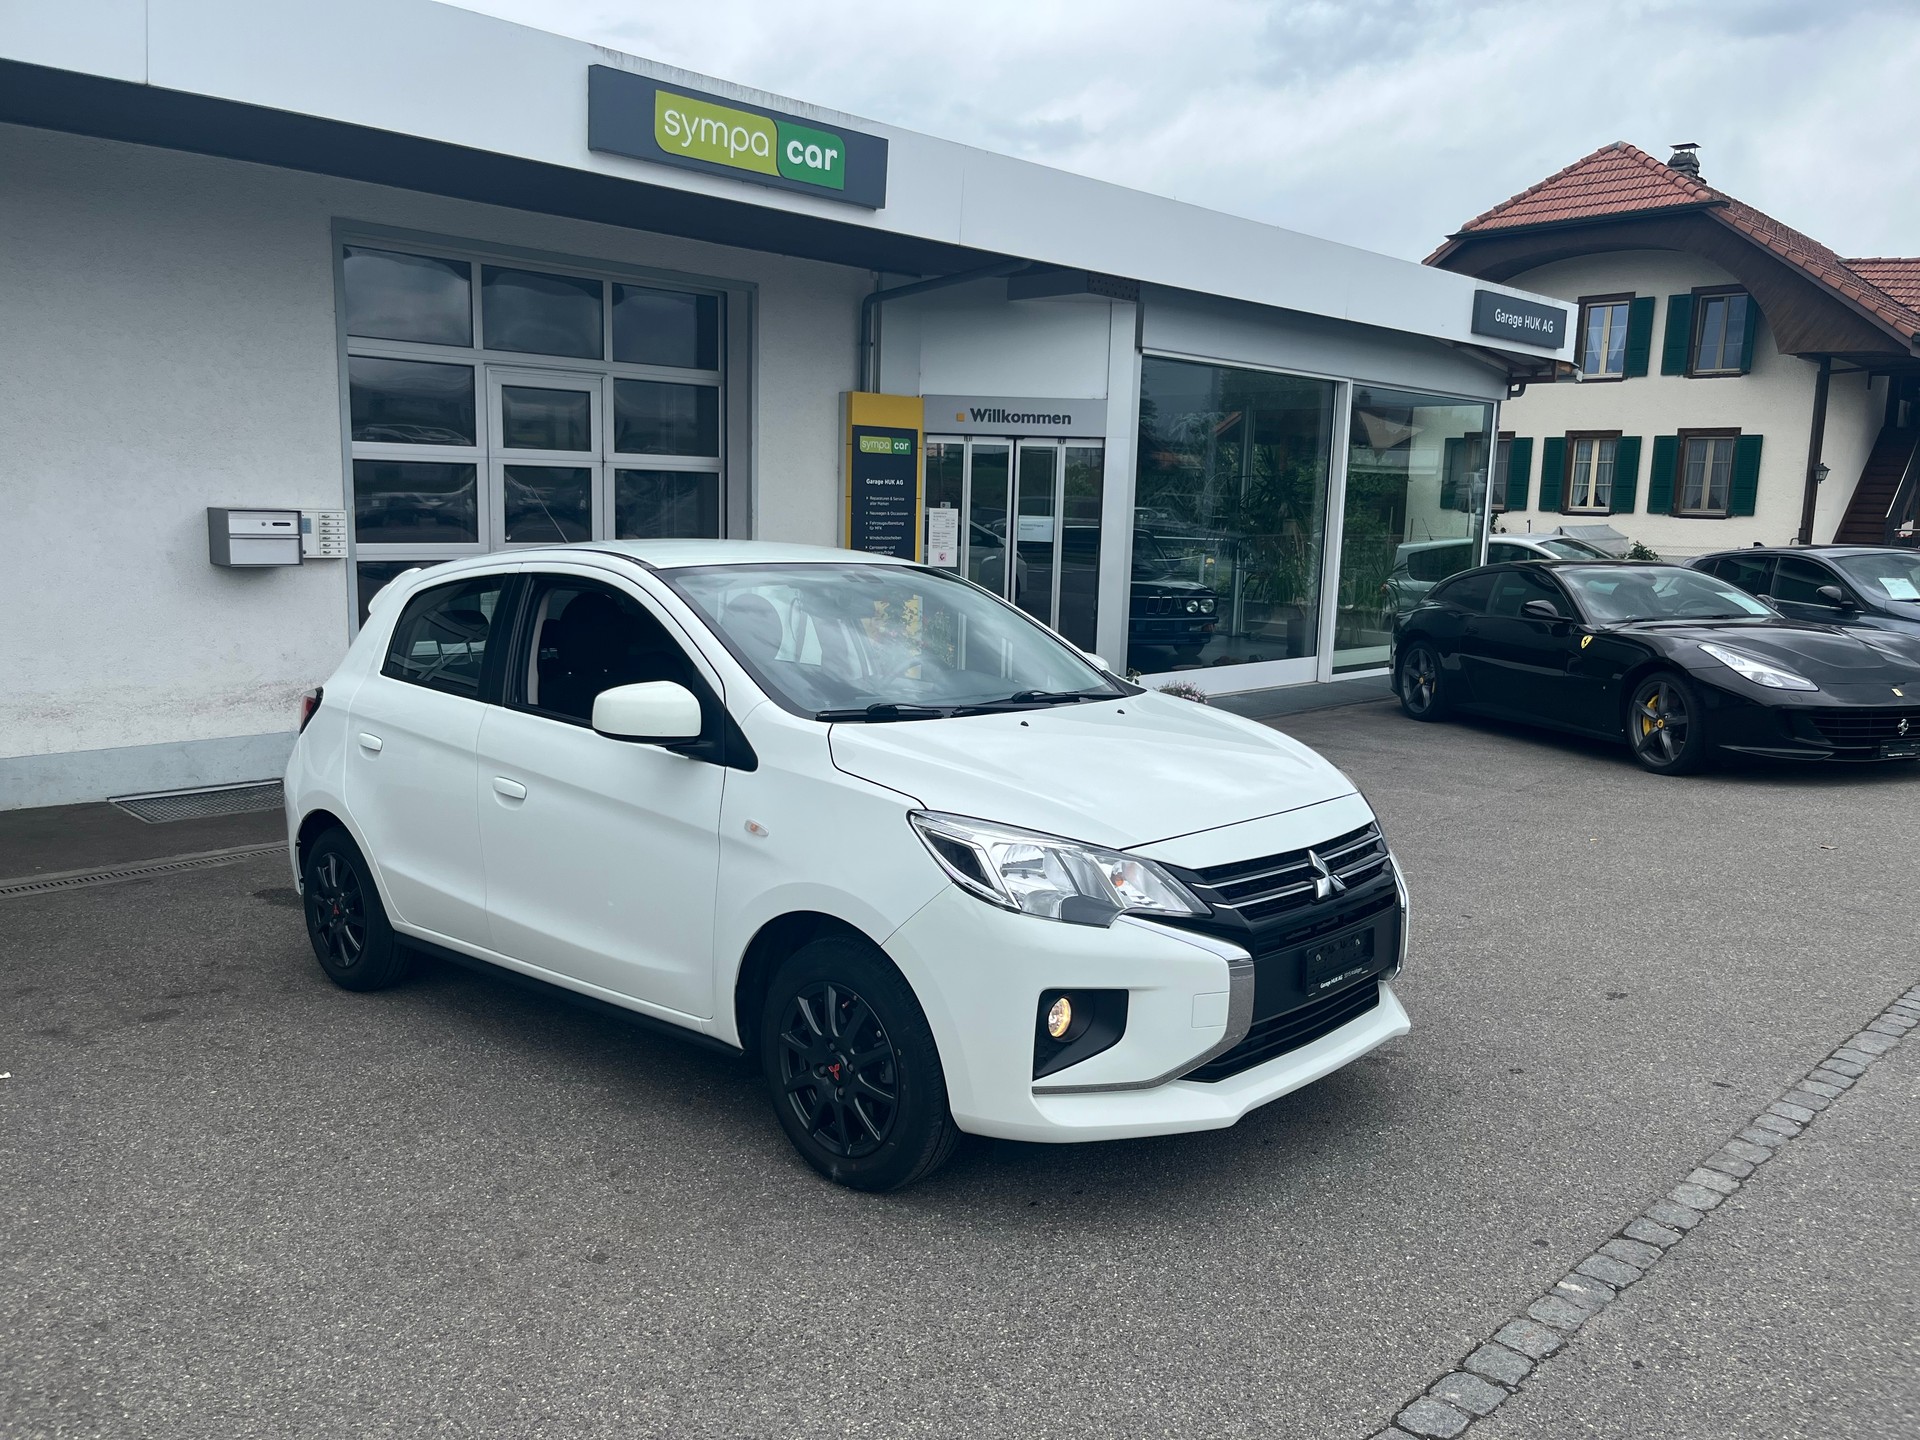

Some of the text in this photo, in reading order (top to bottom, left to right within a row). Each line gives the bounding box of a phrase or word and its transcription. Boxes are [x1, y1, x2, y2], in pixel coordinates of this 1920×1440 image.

[664, 110, 837, 171] sympa car
[1495, 308, 1554, 333] Garage HUK AG
[970, 408, 1072, 425] Willkommen
[861, 440, 909, 451] sympa car
[866, 478, 884, 486] Garage
